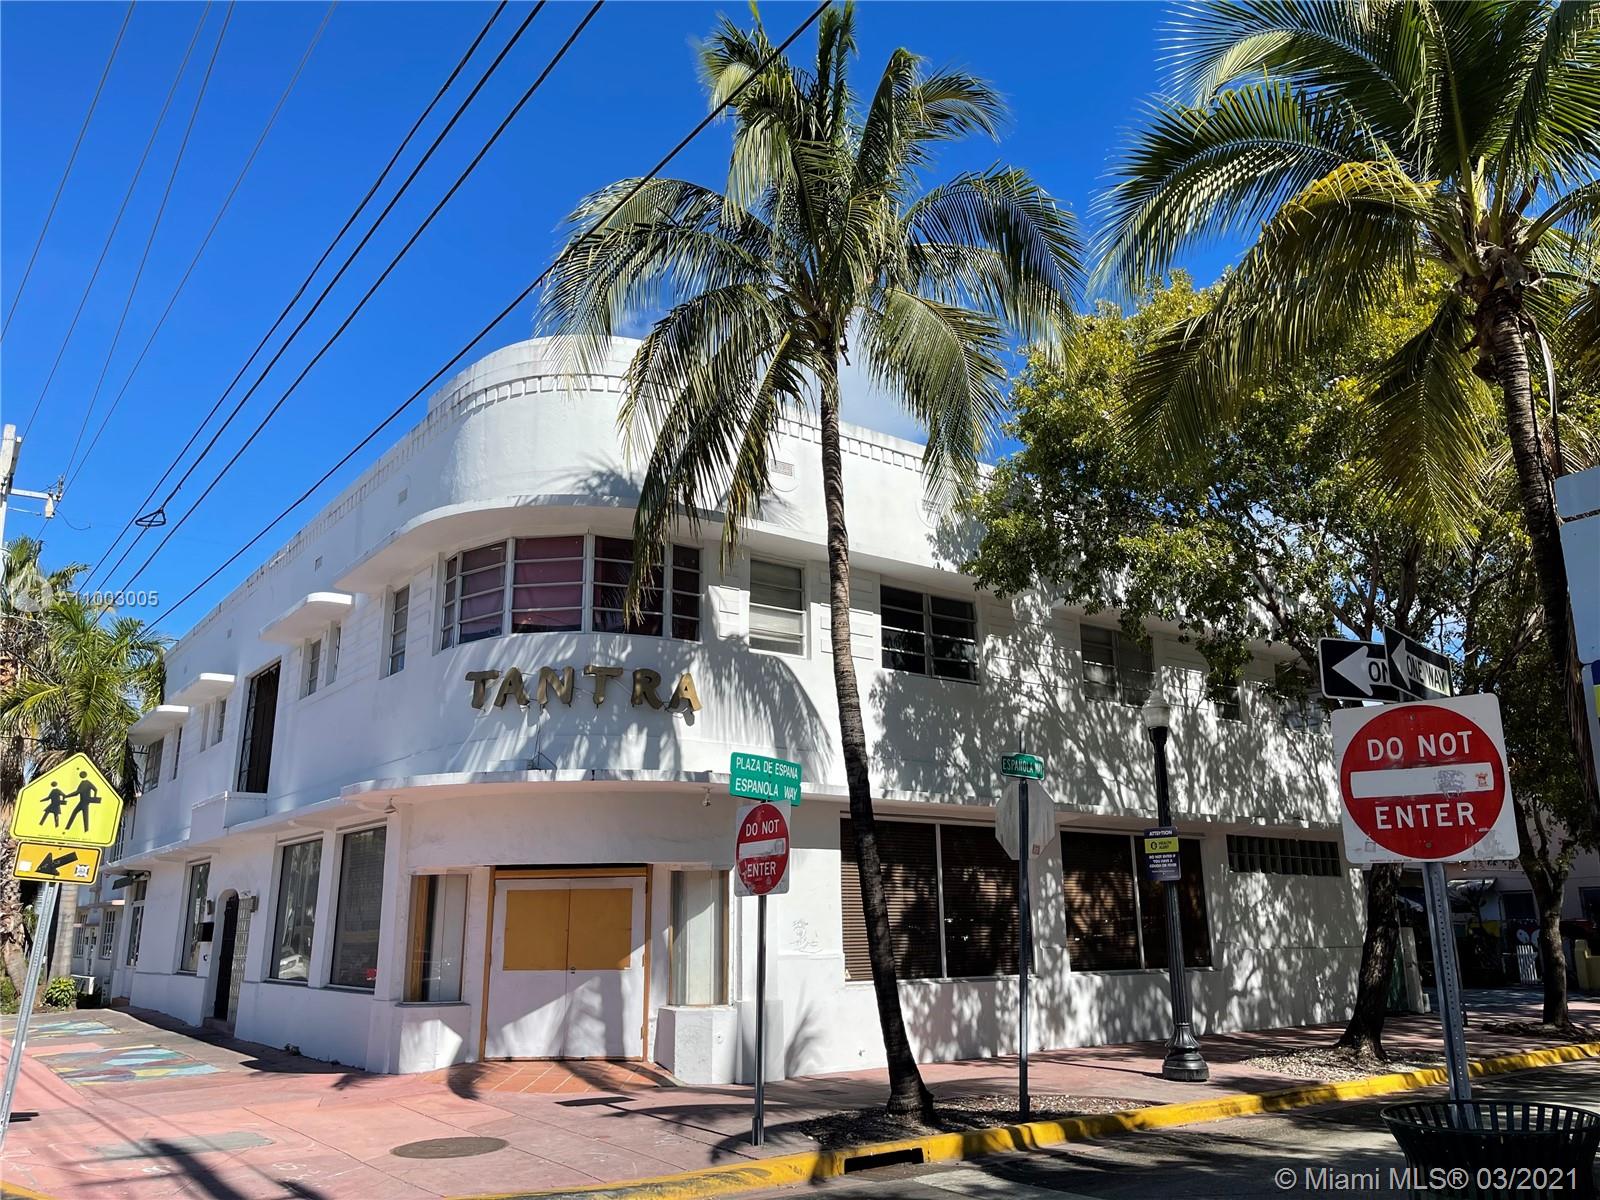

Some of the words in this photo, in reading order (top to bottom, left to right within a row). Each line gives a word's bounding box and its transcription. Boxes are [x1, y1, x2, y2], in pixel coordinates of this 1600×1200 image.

[1368, 661, 1390, 684] ON
[1406, 655, 1424, 682] ONE
[1425, 662, 1445, 692] WAY
[465, 664, 703, 712] TANTRA
[1367, 737, 1404, 761] DO
[1418, 730, 1473, 758] NOT
[736, 756, 760, 772] PLAZA
[763, 760, 773, 774] DE
[775, 762, 798, 780] ESPANA
[735, 777, 779, 797] ESPANOLA
[784, 785, 798, 801] WAY
[745, 822, 758, 837] DO
[762, 819, 779, 835] NOT
[1375, 802, 1476, 830] ENTER
[747, 861, 776, 877] ENTER
